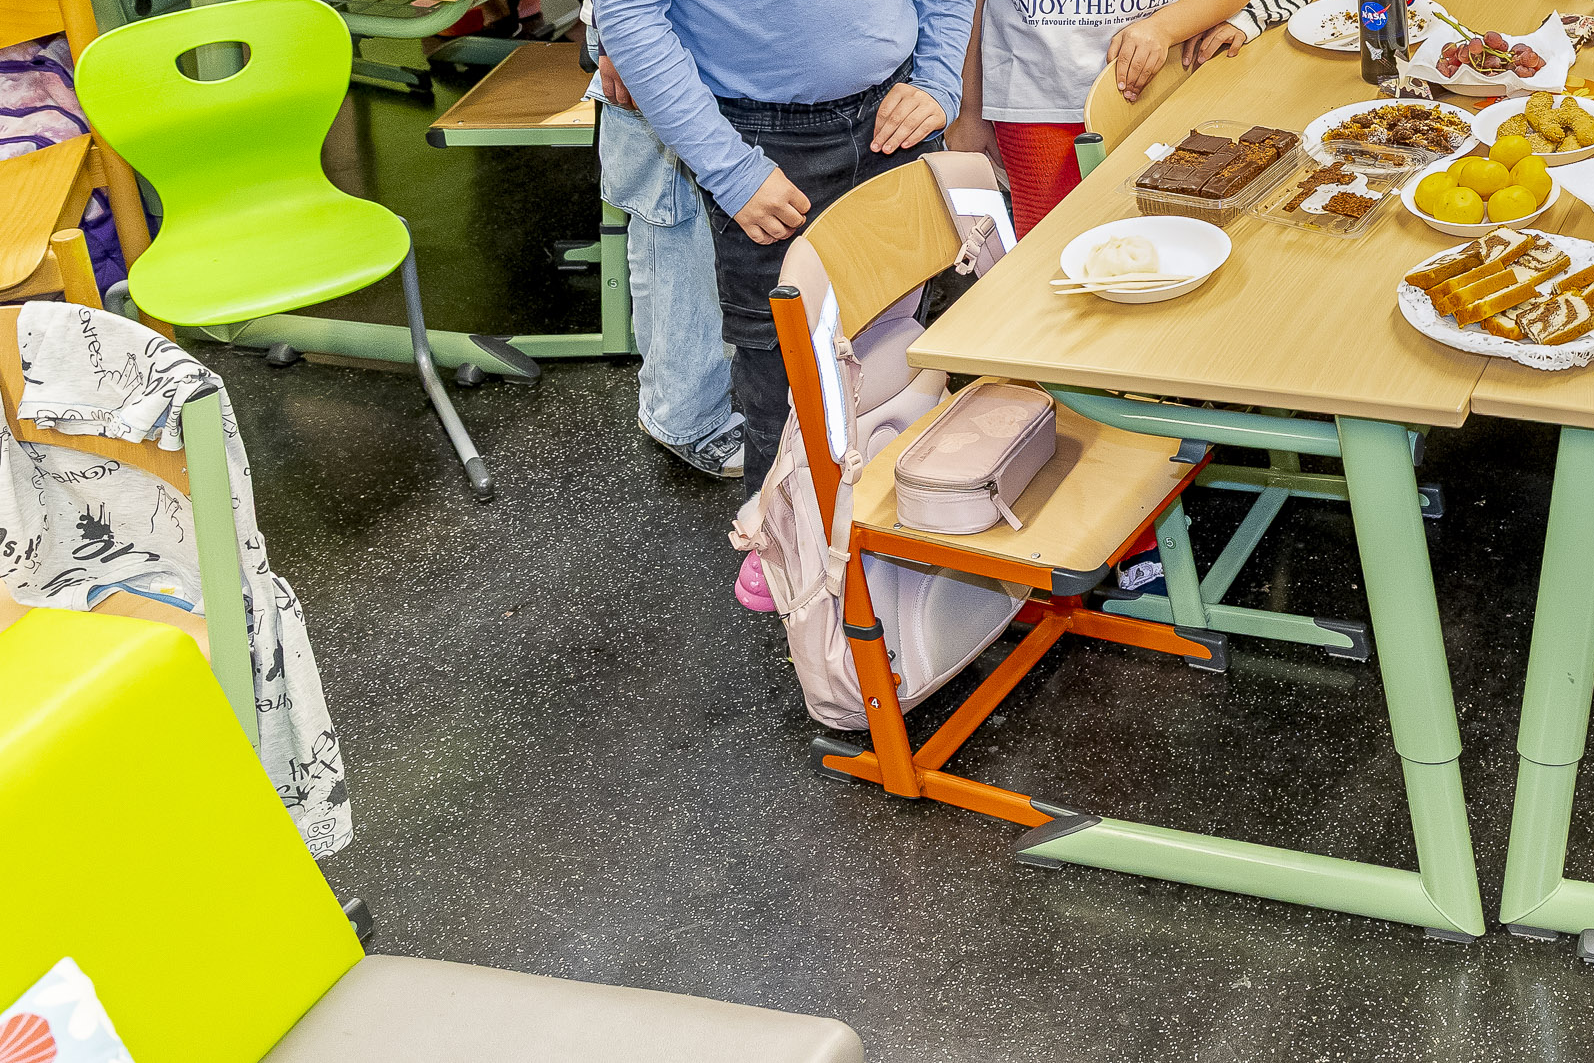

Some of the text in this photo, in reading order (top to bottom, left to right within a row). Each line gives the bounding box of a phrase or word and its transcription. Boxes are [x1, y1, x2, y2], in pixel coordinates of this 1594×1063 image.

[1362, 10, 1387, 21] NASA
[1042, 17, 1076, 26] favourite
[1078, 18, 1103, 27] things
[1113, 16, 1124, 24] the
[1166, 537, 1174, 547] 5
[871, 697, 879, 709] 4
